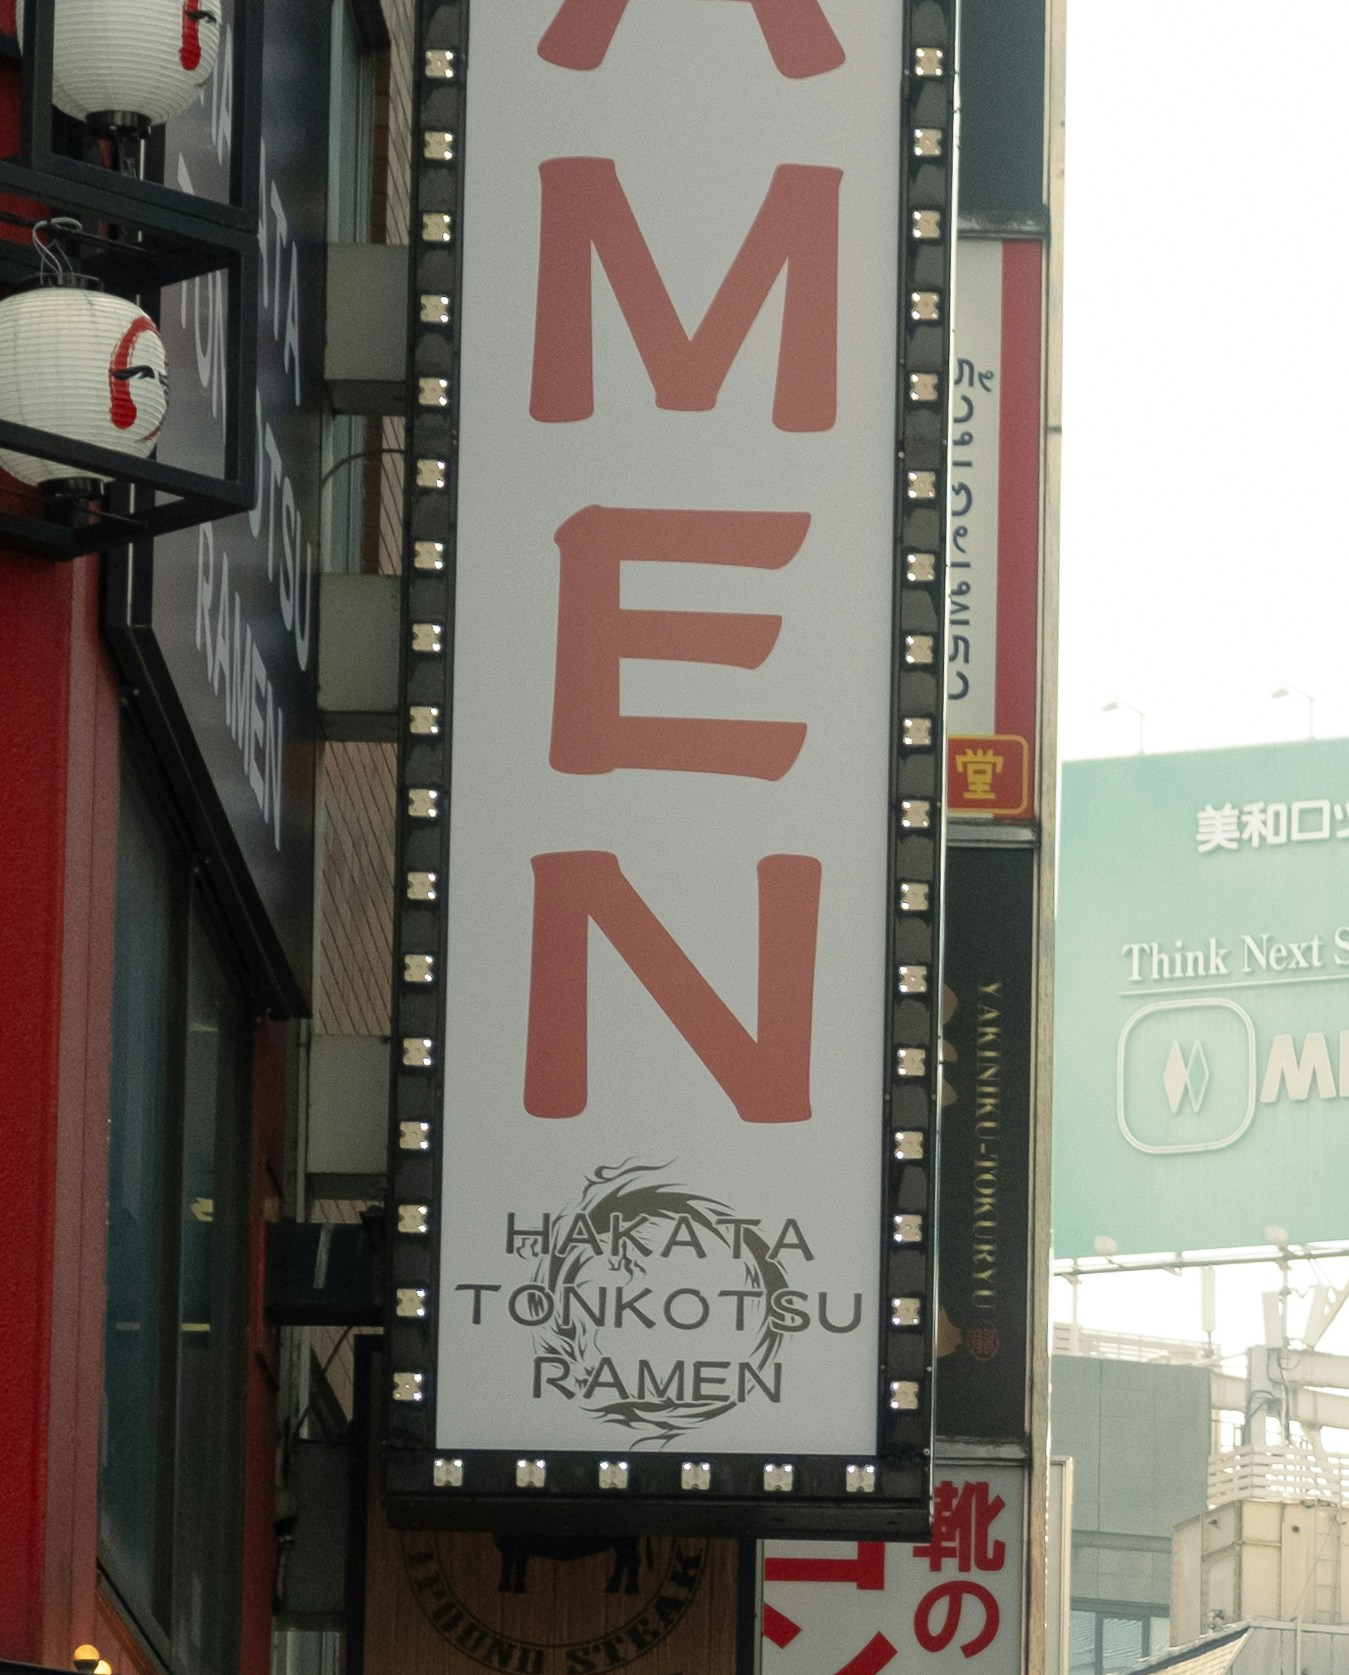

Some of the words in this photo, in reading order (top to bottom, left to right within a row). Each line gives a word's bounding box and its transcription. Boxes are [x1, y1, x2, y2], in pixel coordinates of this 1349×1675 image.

[196, 520, 284, 853] RAMEN
[954, 747, 1004, 803] 堂
[1120, 934, 1231, 984] Think
[1240, 929, 1324, 976] Next
[970, 981, 1002, 1310] YAKINIKU-TOKURYU
[503, 1212, 813, 1262] HAKATA
[454, 1283, 863, 1335] TONKOTSU
[531, 1356, 783, 1404] RAMEN
[911, 1477, 1005, 1661] 靴の
[416, 1566, 545, 1675] POUND
[564, 1545, 706, 1675] STEAK
